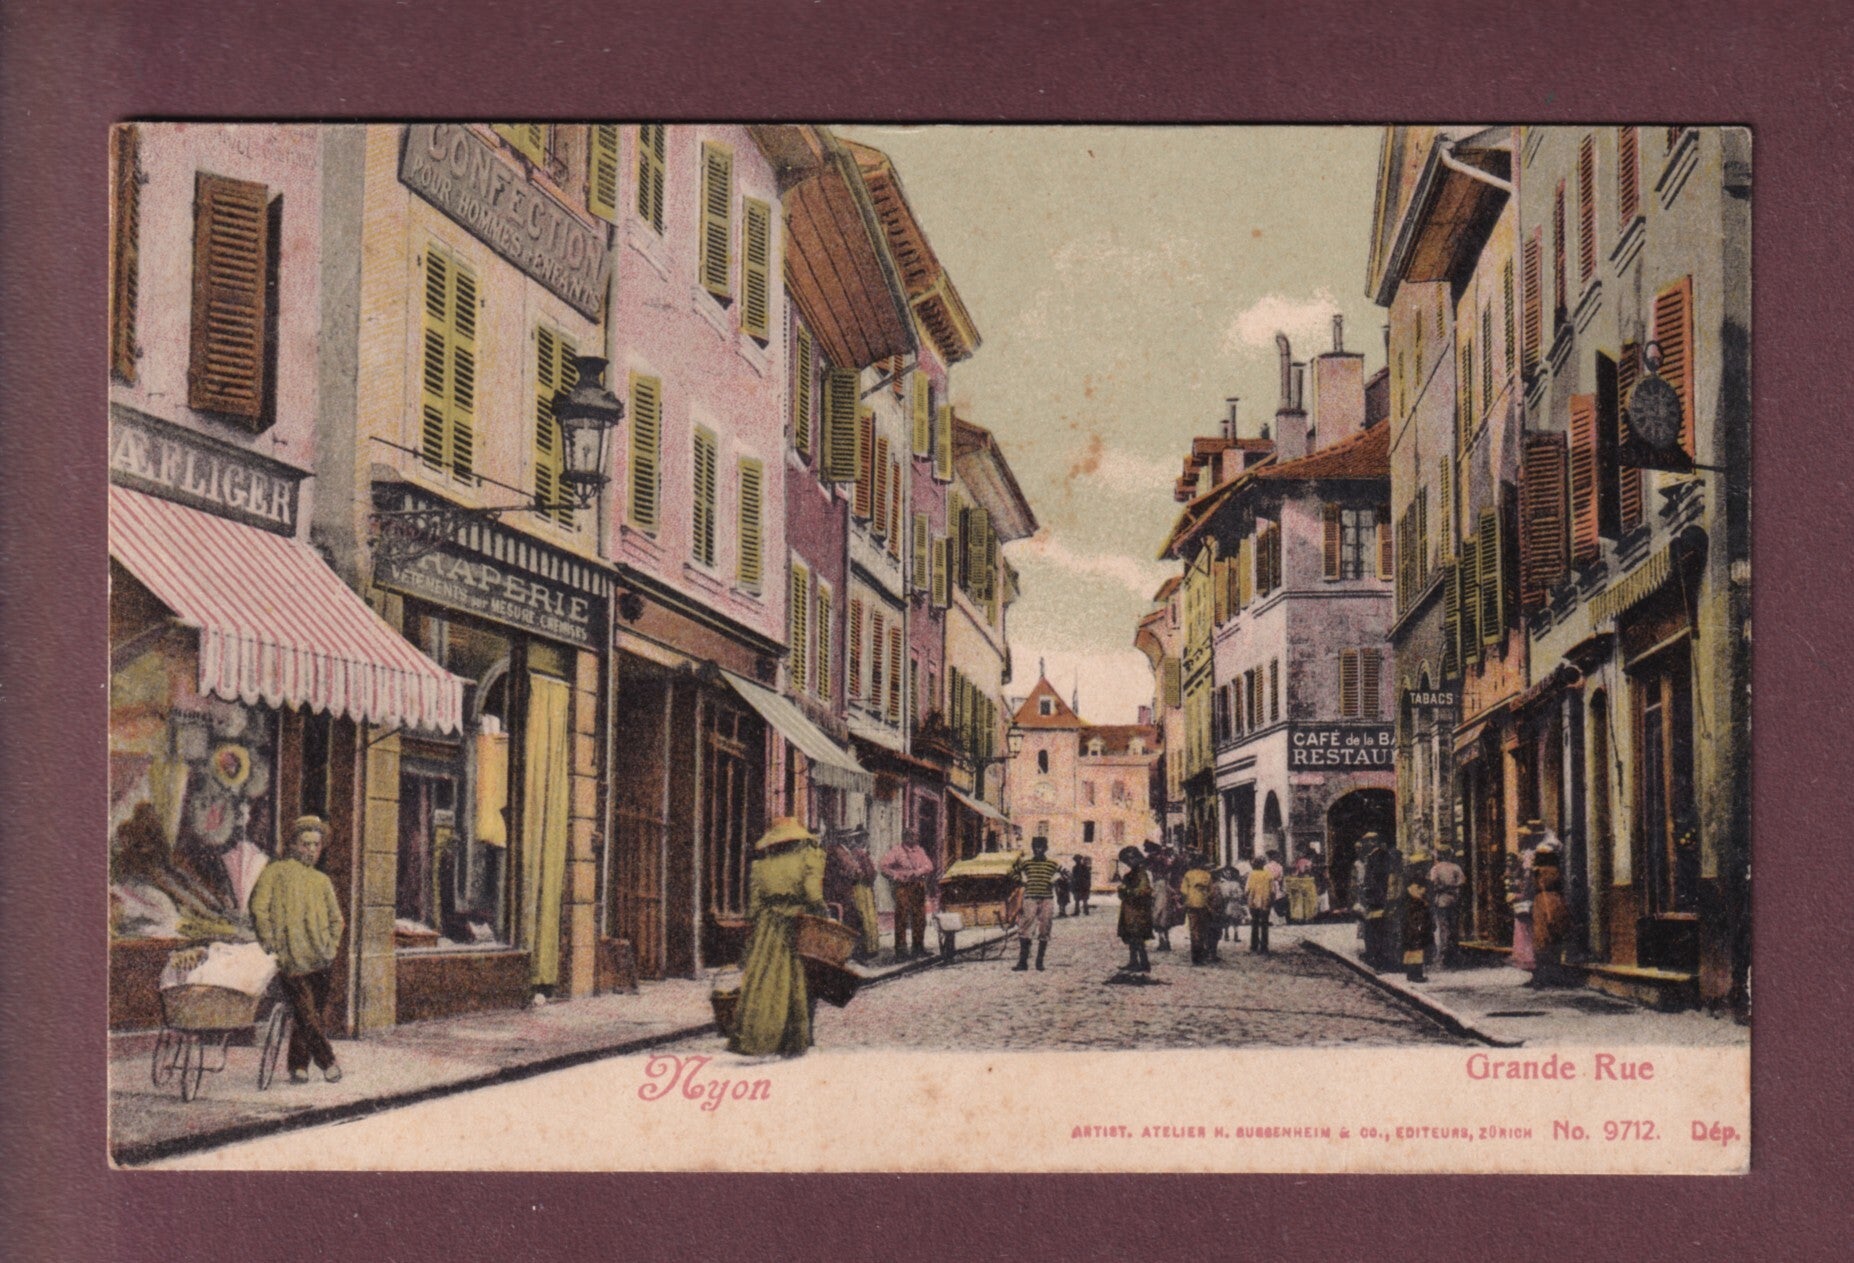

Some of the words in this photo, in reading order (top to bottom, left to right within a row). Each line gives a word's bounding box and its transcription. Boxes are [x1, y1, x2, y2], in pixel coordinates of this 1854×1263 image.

[490, 597, 535, 624] MESURE
[1410, 692, 1454, 705] TABACS
[1293, 730, 1341, 747] CAFÉ
[1345, 732, 1361, 747] de
[1363, 731, 1375, 747] la
[1293, 748, 1395, 766] RESTAU
